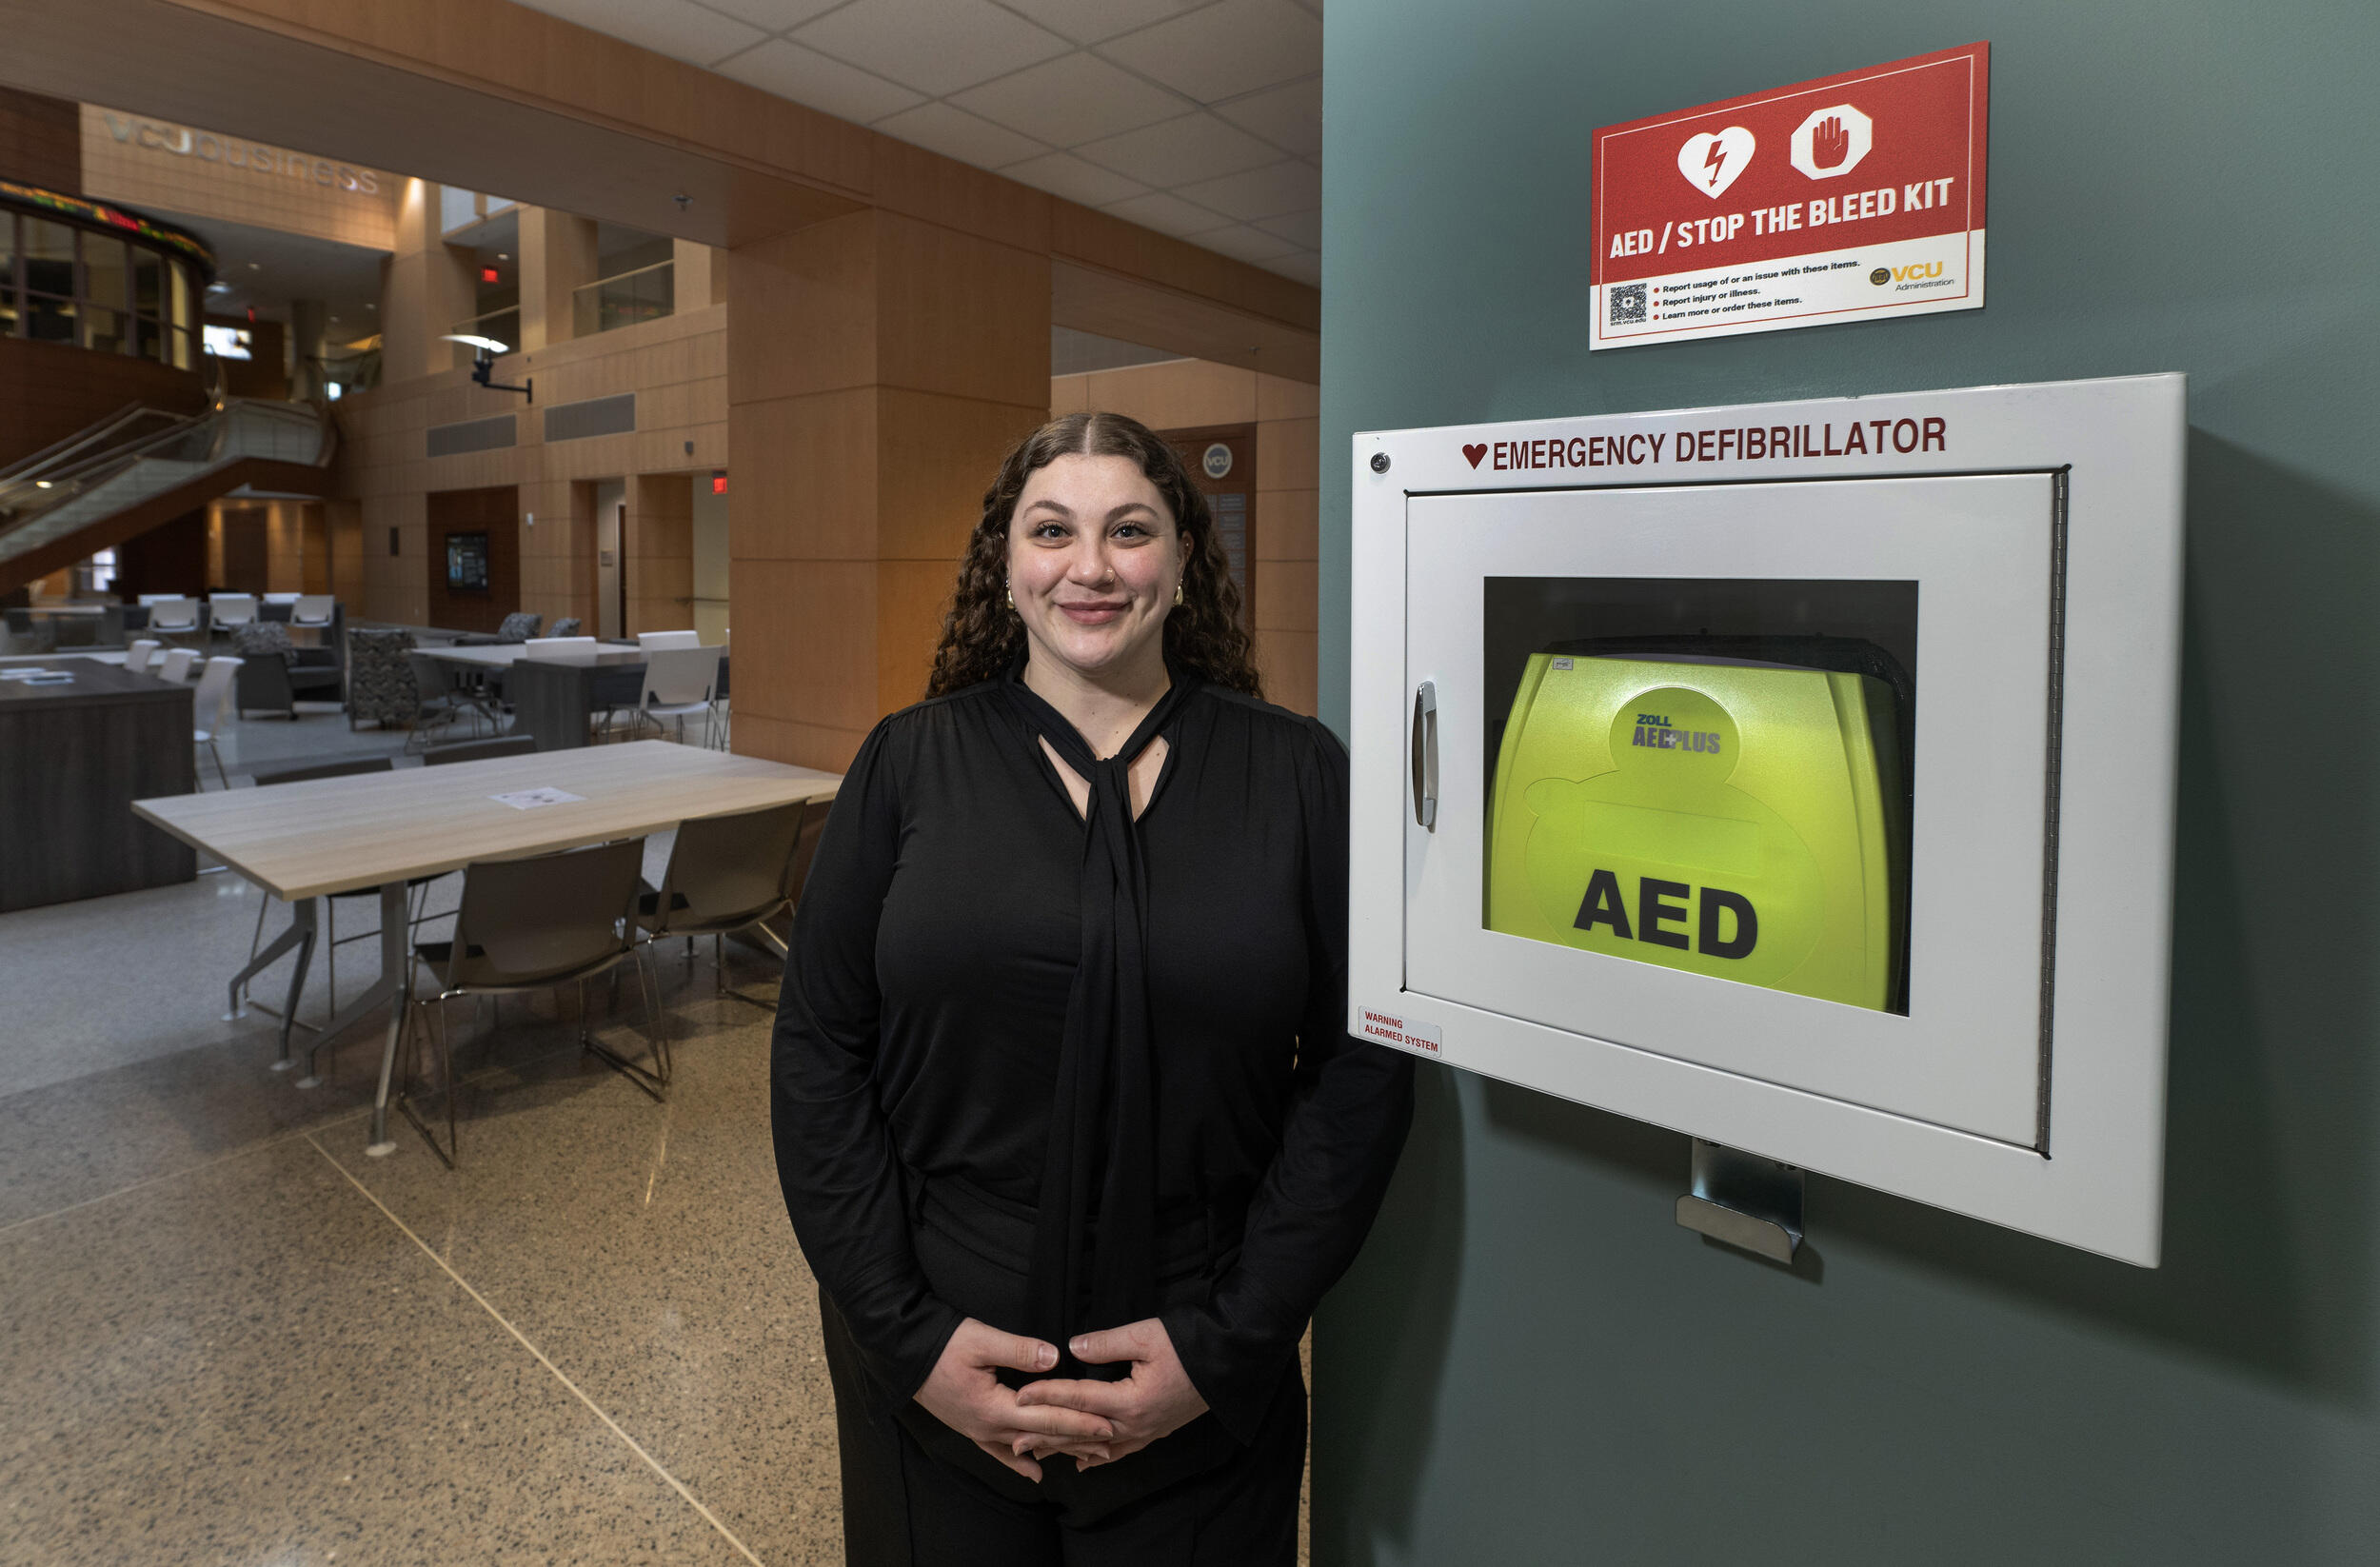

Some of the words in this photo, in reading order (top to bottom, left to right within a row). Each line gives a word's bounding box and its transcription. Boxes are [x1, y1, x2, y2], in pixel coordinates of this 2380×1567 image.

[1609, 228, 1654, 259] AED
[1657, 221, 1674, 255] /
[1677, 213, 1745, 248] STOP
[1751, 202, 1803, 236] THE
[1808, 188, 1897, 228] BLEED
[1903, 176, 1954, 212] KIT
[1662, 283, 1691, 293] Report
[1693, 280, 1717, 289] usage
[1755, 271, 1779, 281] issue
[1781, 268, 1800, 277] with
[1803, 265, 1828, 273] these
[1831, 260, 1860, 270] items.
[1891, 261, 1943, 283] VCU
[1895, 279, 1954, 291] Administration
[1662, 296, 1691, 307] Report
[1693, 293, 1716, 303] injury
[1730, 288, 1760, 298] illness.
[1662, 311, 1686, 320] Learn
[1688, 307, 1709, 317] more
[1722, 304, 1746, 312] order
[1747, 301, 1772, 309] these
[1775, 297, 1803, 307] items.
[1493, 433, 1666, 470] EMERGENCY
[1676, 417, 1947, 462] DEFIBRILLATOR
[1206, 455, 1228, 466] VCU
[1636, 713, 1672, 727] ZOLL
[1573, 868, 1758, 960] AED
[1364, 1011, 1403, 1029] WARNING
[1364, 1024, 1402, 1042] ALARMED
[1405, 1035, 1438, 1052] SYSTEM
